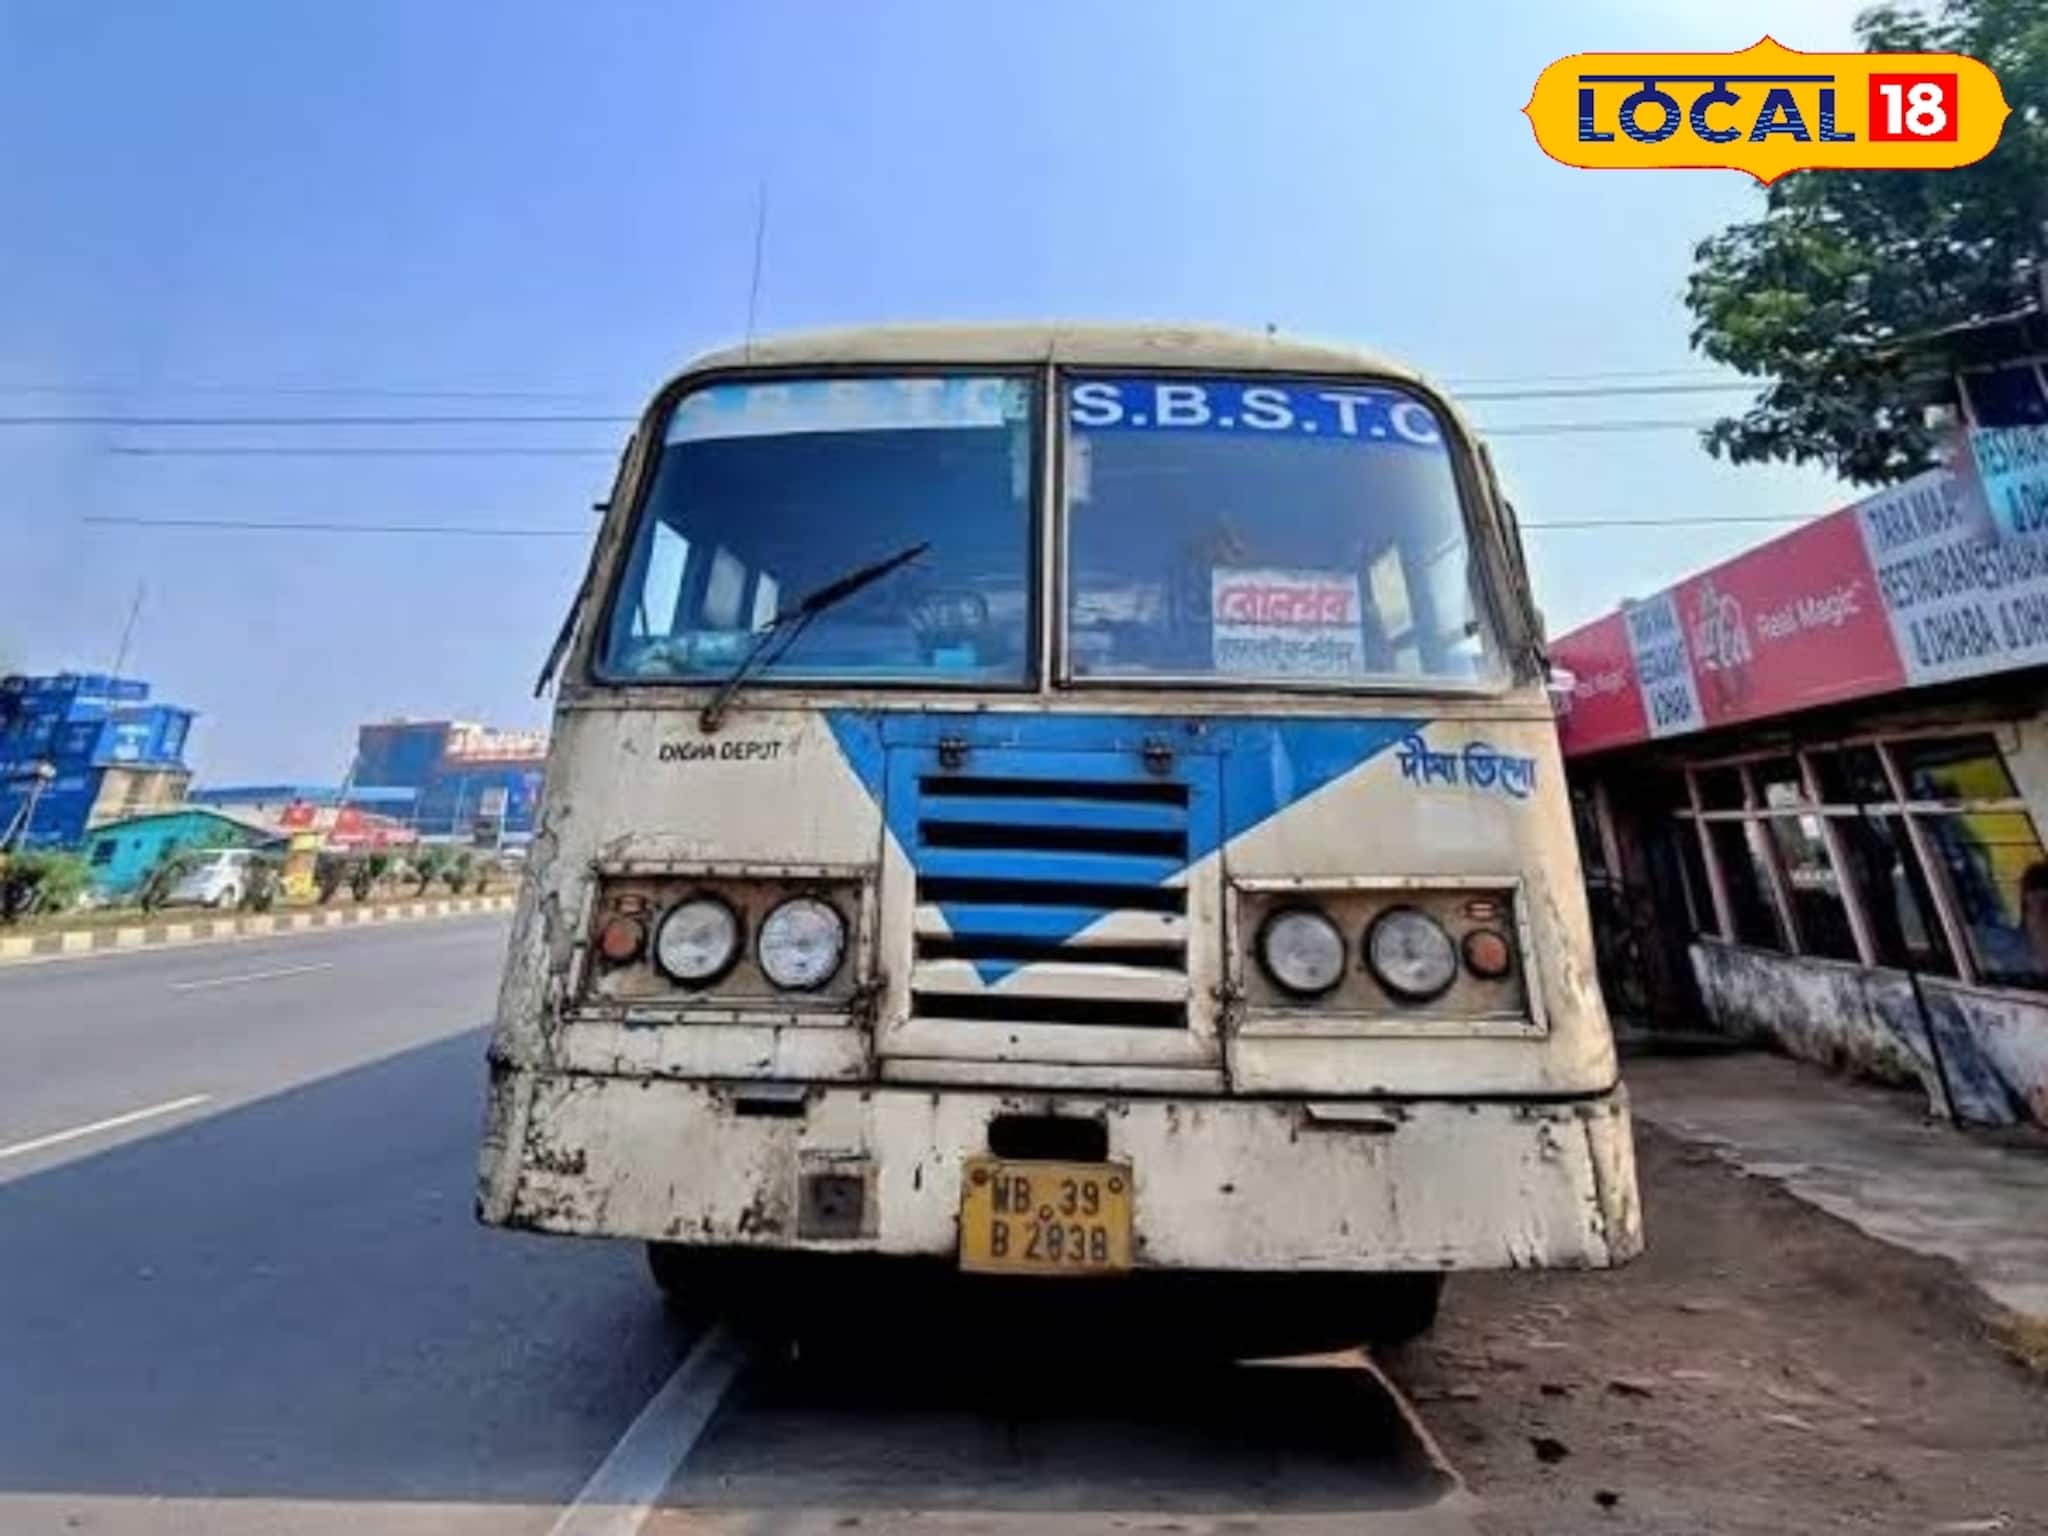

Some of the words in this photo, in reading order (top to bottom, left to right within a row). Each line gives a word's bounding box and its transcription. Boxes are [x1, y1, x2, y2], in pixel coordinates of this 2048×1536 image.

[991, 1172, 1031, 1214] WB
[1059, 1178, 1100, 1217] 39
[990, 1219, 1009, 1258] B
